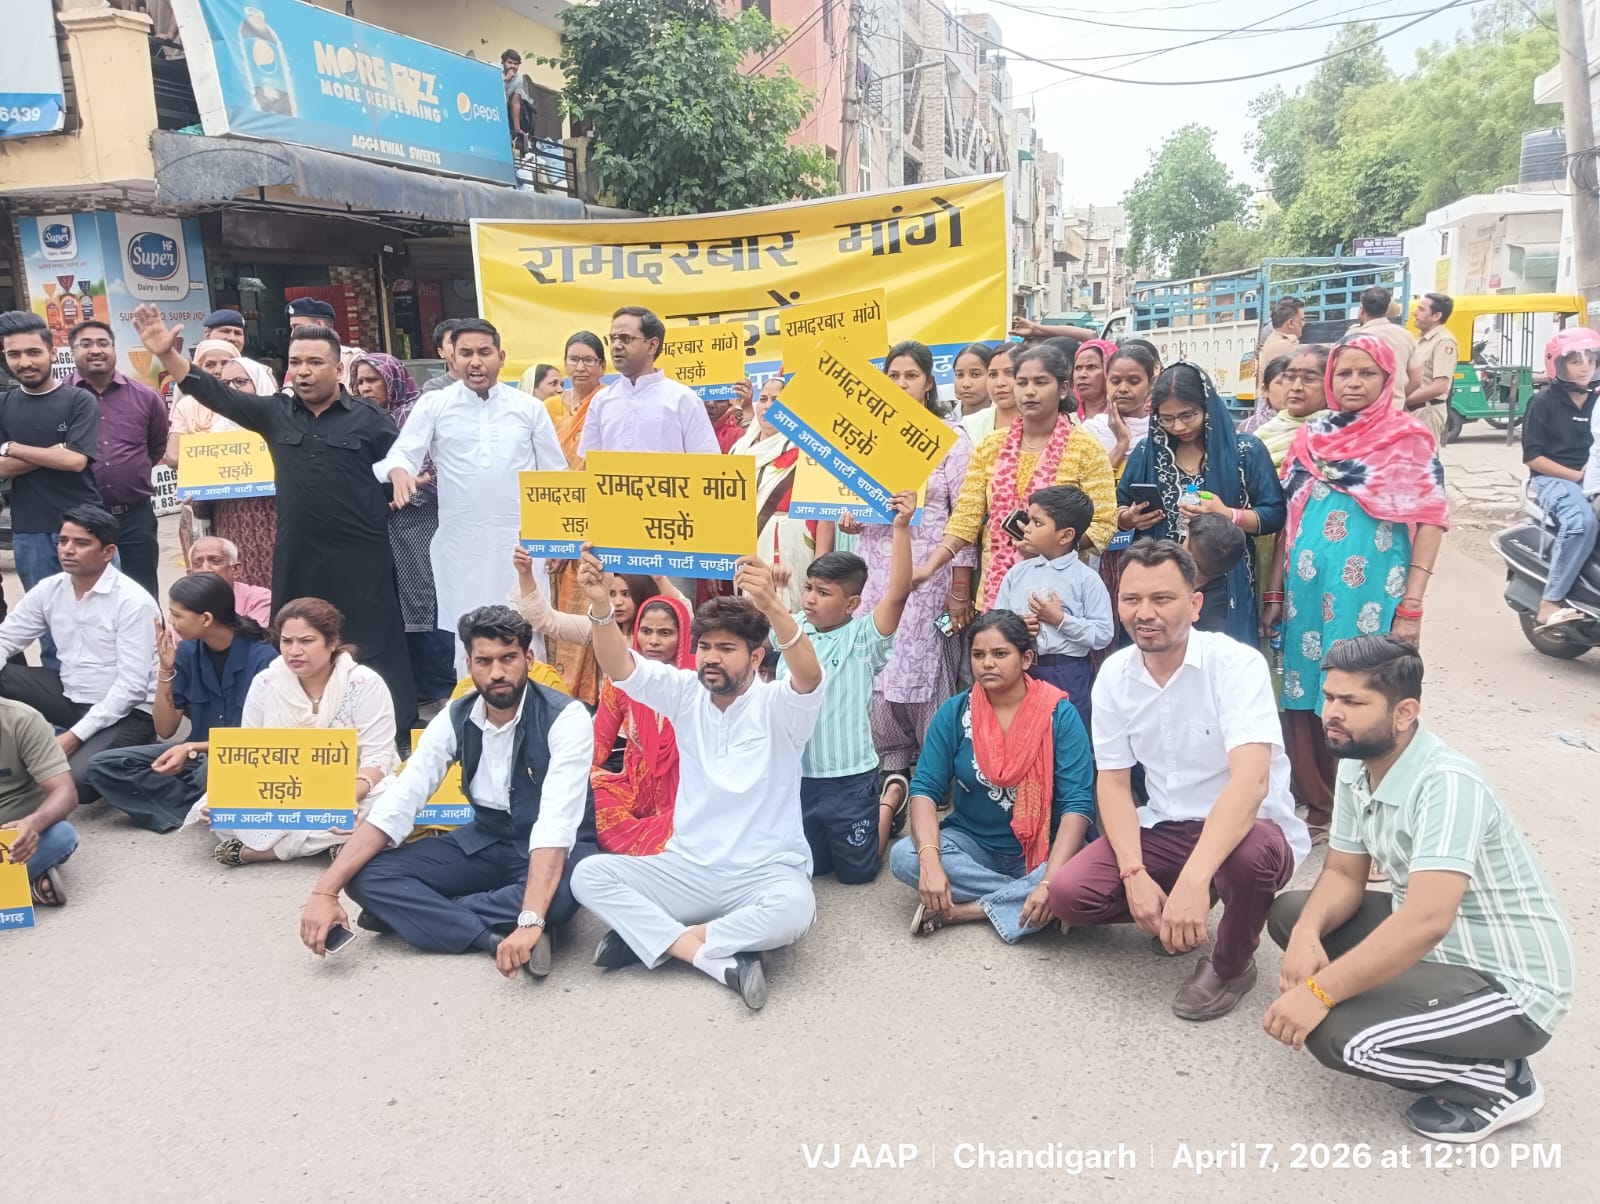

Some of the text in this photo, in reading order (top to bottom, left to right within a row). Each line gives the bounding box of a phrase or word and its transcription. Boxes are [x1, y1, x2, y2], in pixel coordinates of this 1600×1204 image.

[313, 40, 388, 90] MORE
[320, 79, 362, 103] MORE
[472, 103, 500, 122] pepsi
[352, 134, 440, 165] AGGARWAL SWEETS
[162, 240, 173, 251] HF
[518, 196, 965, 285] रामदरबार मांगे
[132, 246, 175, 269] Super
[169, 312, 190, 320] SUPER
[785, 300, 881, 337] रामदरबार मांगे
[711, 332, 738, 351] मांगे
[675, 361, 706, 382] सड़कें
[817, 350, 898, 426] रामदरबार
[899, 420, 940, 461] मांगे
[773, 410, 799, 431] आम
[798, 430, 832, 459] आदमी
[832, 456, 857, 478] पार्टी
[832, 412, 878, 456] सड़कें
[184, 442, 252, 459] रामदरबार
[217, 461, 254, 480] सड़कें
[204, 486, 230, 495] आदमी
[594, 470, 747, 501] रामदरबार मांगे
[795, 506, 816, 514] आम
[851, 507, 873, 517] पार्टी
[642, 511, 694, 545] सड़कें
[528, 543, 576, 553] आम आदमी
[1111, 535, 1131, 544] आम
[599, 554, 622, 565] आम
[627, 554, 663, 568] आदमी
[668, 555, 694, 569] पार्टी
[216, 741, 349, 768] रामदरबार मांगे
[257, 775, 302, 804] सड़कें
[213, 811, 347, 826] आम आदमी पार्टी चण्डीगढ़
[416, 808, 470, 818] आम आदमी
